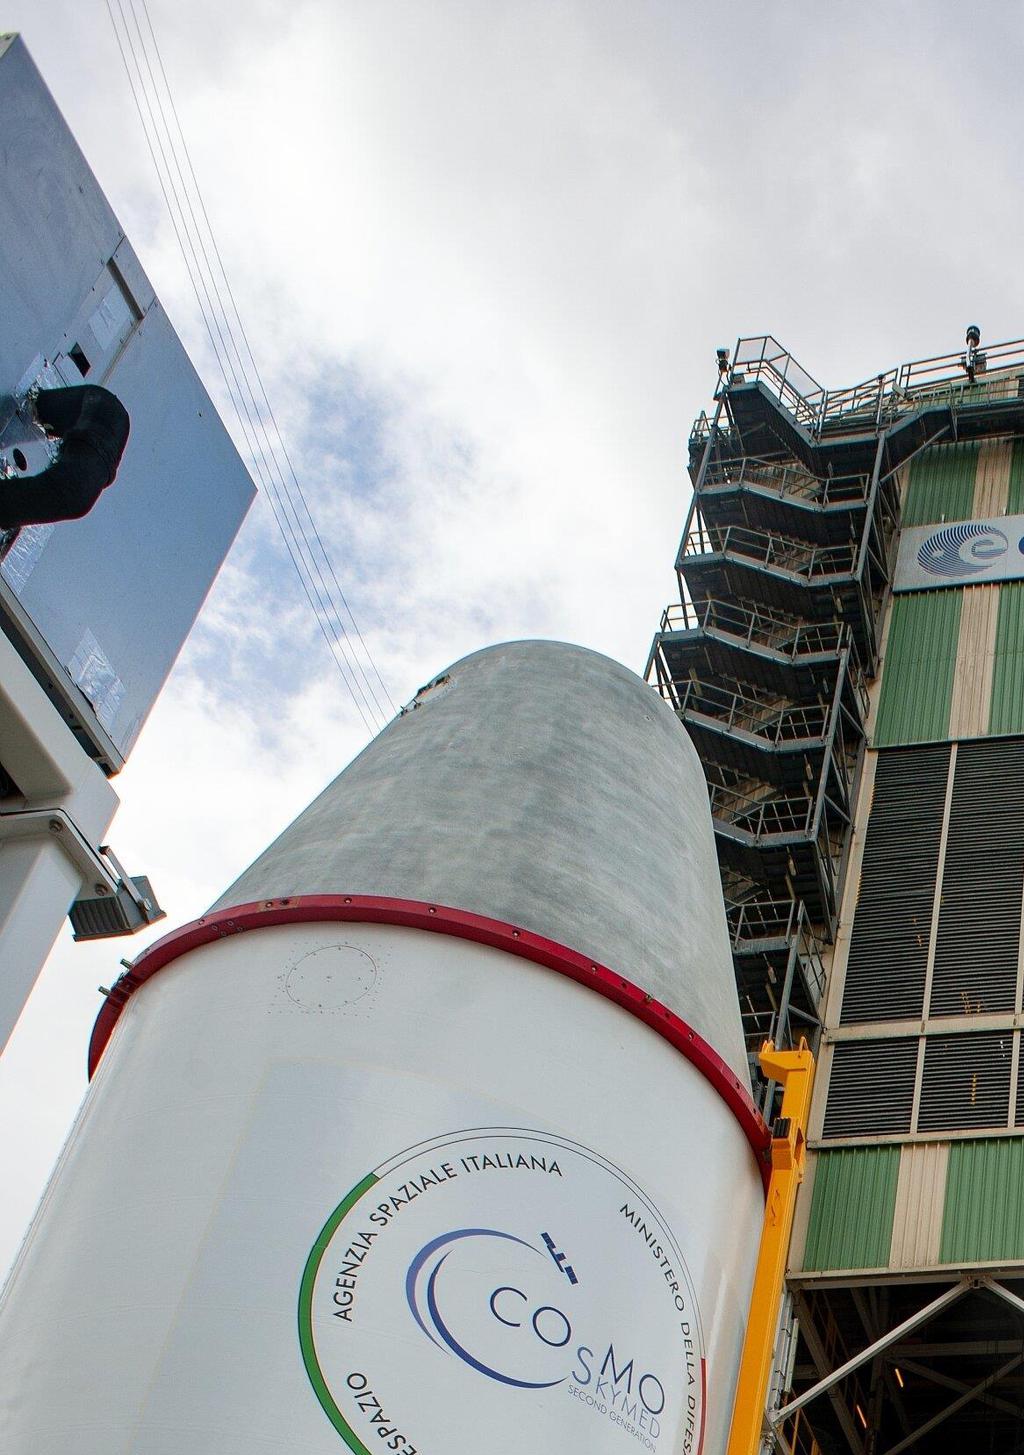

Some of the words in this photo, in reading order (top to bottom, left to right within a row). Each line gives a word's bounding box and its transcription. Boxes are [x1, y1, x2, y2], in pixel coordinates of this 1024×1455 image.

[333, 1231, 377, 1322] AGENZIA
[369, 1163, 458, 1227] SPAZIALE
[461, 1153, 563, 1177] ITALIANA
[619, 1203, 685, 1312] MINISTERO
[680, 1321, 696, 1386] DELLA
[567, 1384, 608, 1414] SECOND
[609, 1411, 657, 1453] GENERATION
